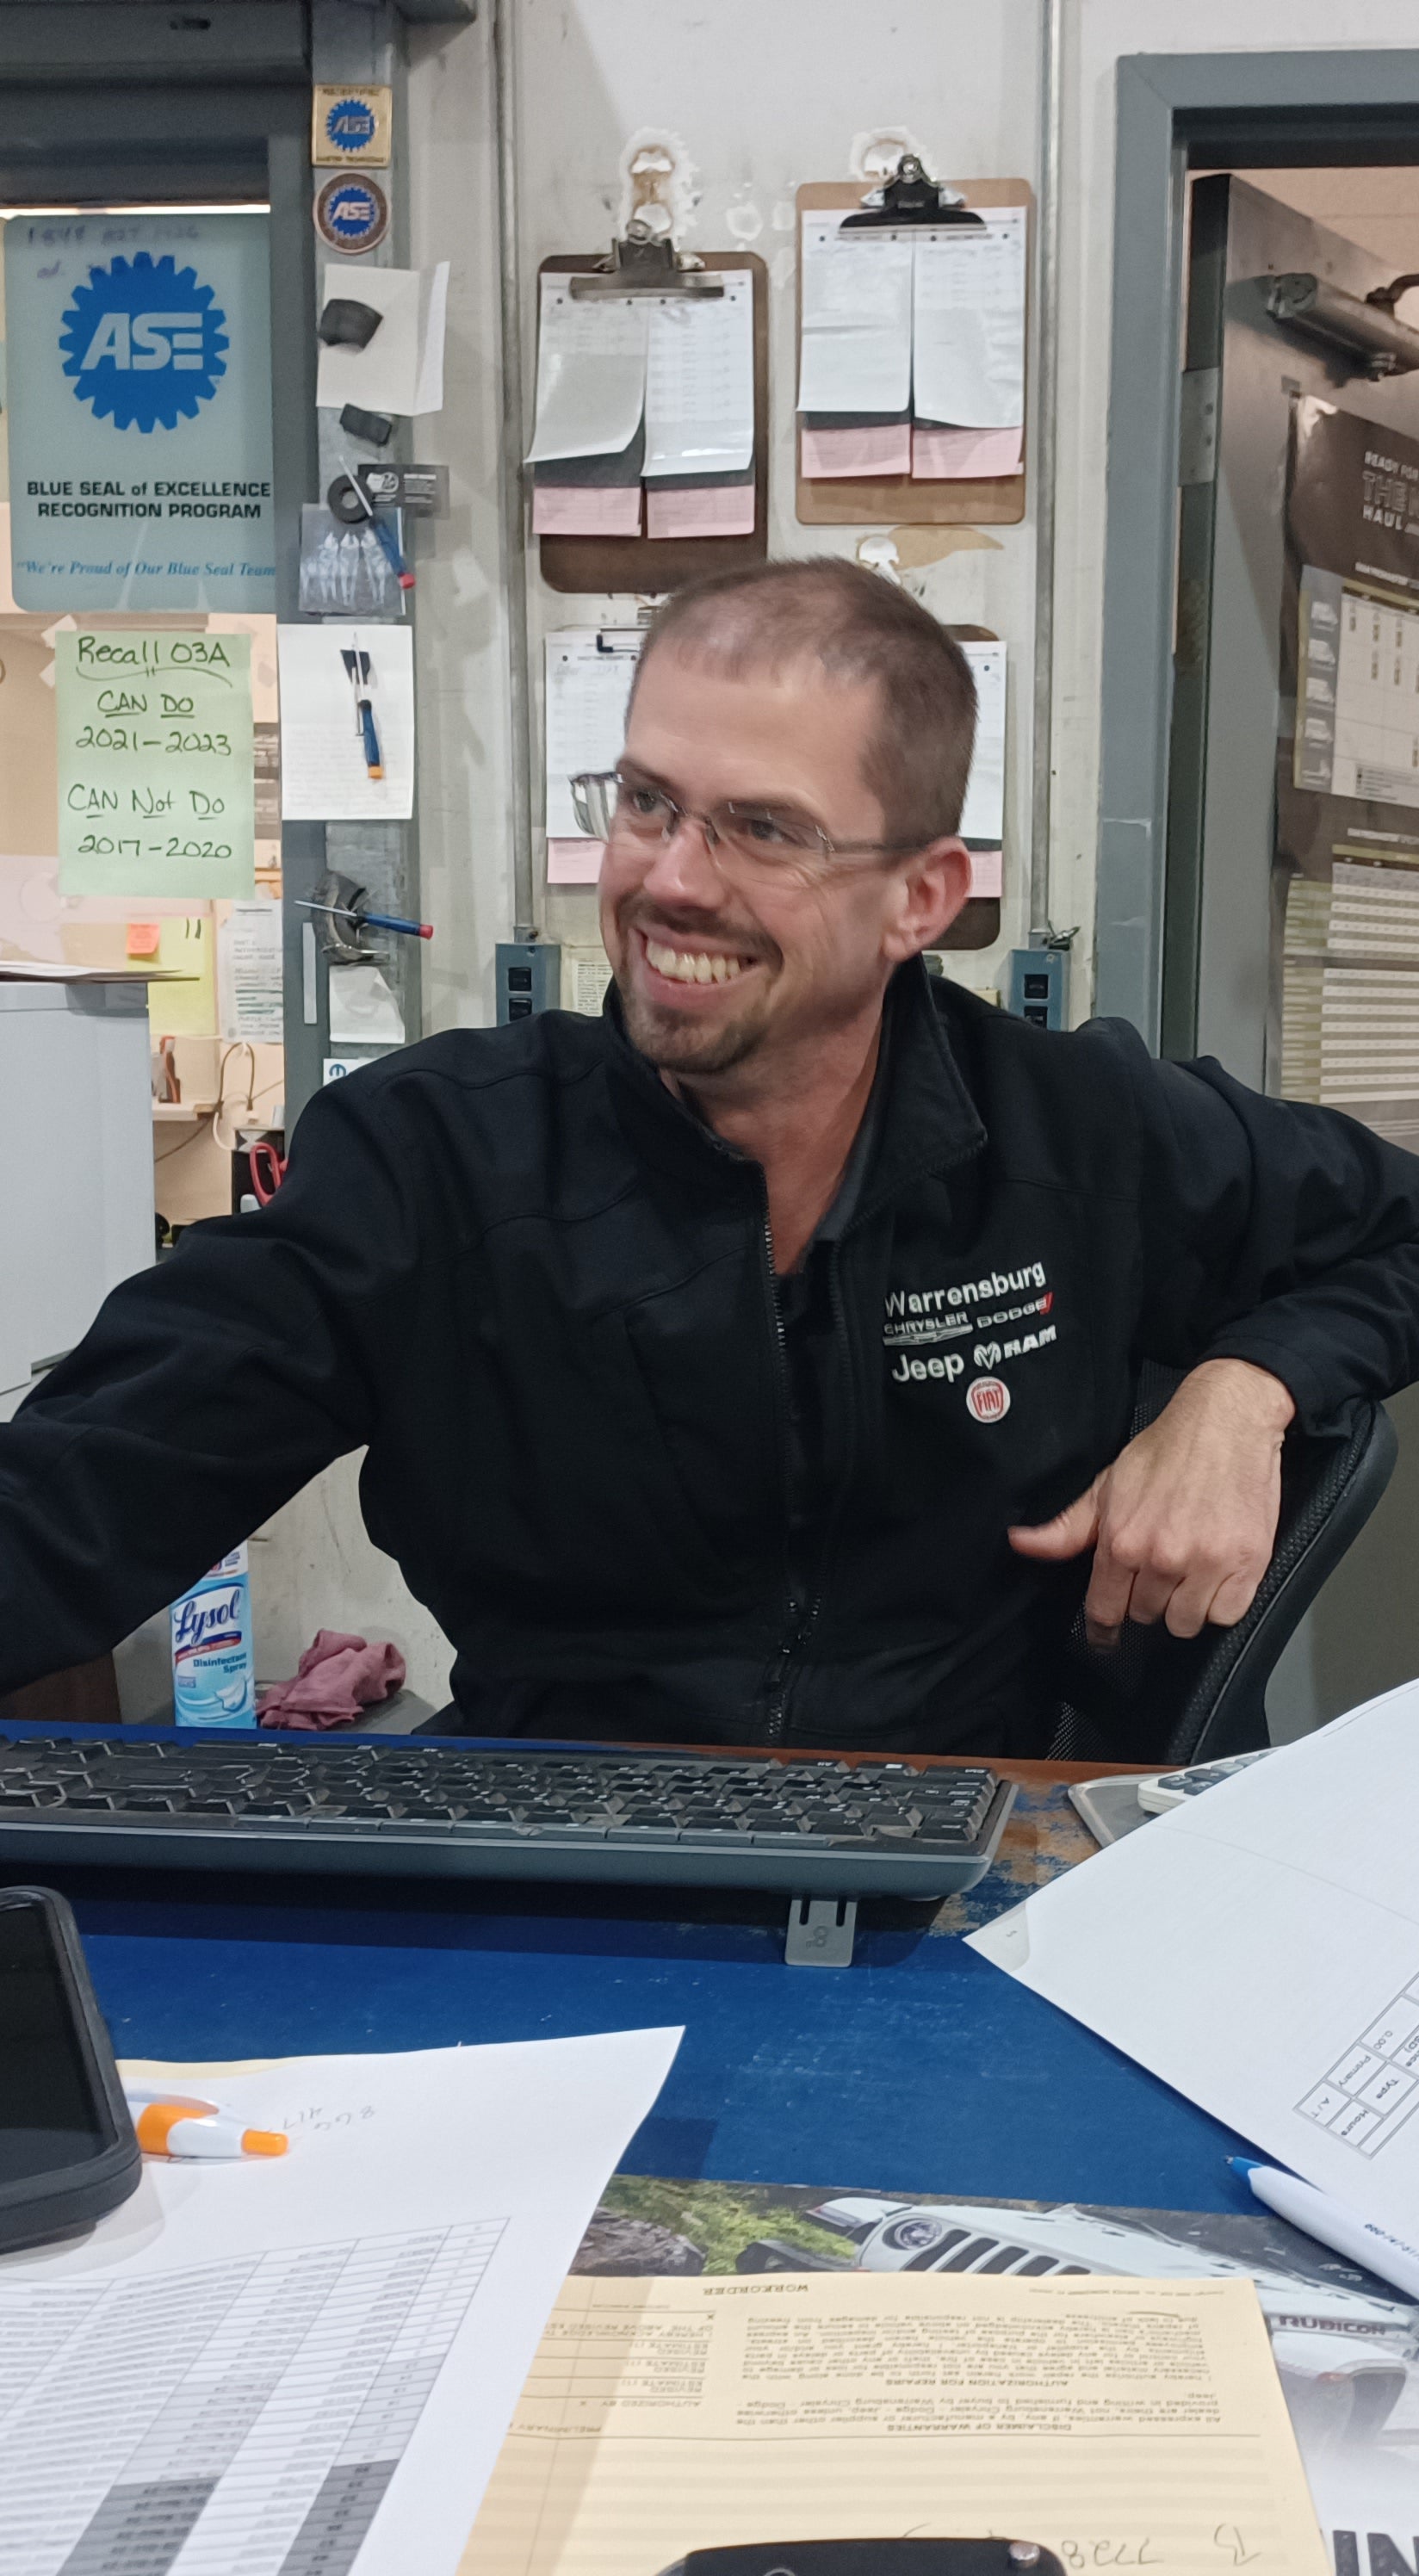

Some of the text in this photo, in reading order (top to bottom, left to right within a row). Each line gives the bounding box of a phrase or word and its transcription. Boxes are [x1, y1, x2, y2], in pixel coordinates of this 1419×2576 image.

[332, 115, 371, 135] ASE
[331, 201, 371, 222] ASE
[80, 312, 204, 371] ASE
[1365, 450, 1399, 474] READY
[27, 481, 271, 498] BLUE SEAL of EXCELLENCE
[38, 502, 262, 518] RECOGNITION PROGRAM
[1362, 505, 1404, 530] HAUL
[69, 560, 113, 574] Proud
[116, 560, 132, 578] of
[134, 561, 164, 574] Our
[167, 561, 200, 575] Blue
[205, 561, 234, 575] Seal
[77, 635, 159, 665] Recall
[97, 690, 195, 714] CAN DO
[67, 783, 118, 811] CAN
[132, 786, 177, 814] Not
[884, 1261, 1047, 1317] Warrensburg
[883, 1297, 1048, 1335] CHRYSLER DODGE
[891, 1324, 1057, 1383] Jeep RAM
[976, 1389, 1001, 1413] FIAT
[173, 1588, 241, 1647] Lysol
[193, 1651, 247, 1668] Disinfectant
[223, 1661, 247, 1673] Spray
[1337, 2054, 1372, 2087] Primary
[1376, 2076, 1400, 2100] Type
[1309, 2096, 1331, 2119] A/T
[1340, 2108, 1369, 2137] Hours
[702, 2284, 809, 2296] WORKORDER
[1279, 2314, 1386, 2336] RUBICON
[600, 2400, 617, 2408] BY
[518, 2424, 603, 2433] PRELIMINARY
[997, 2423, 1073, 2431] DISCLAIMER
